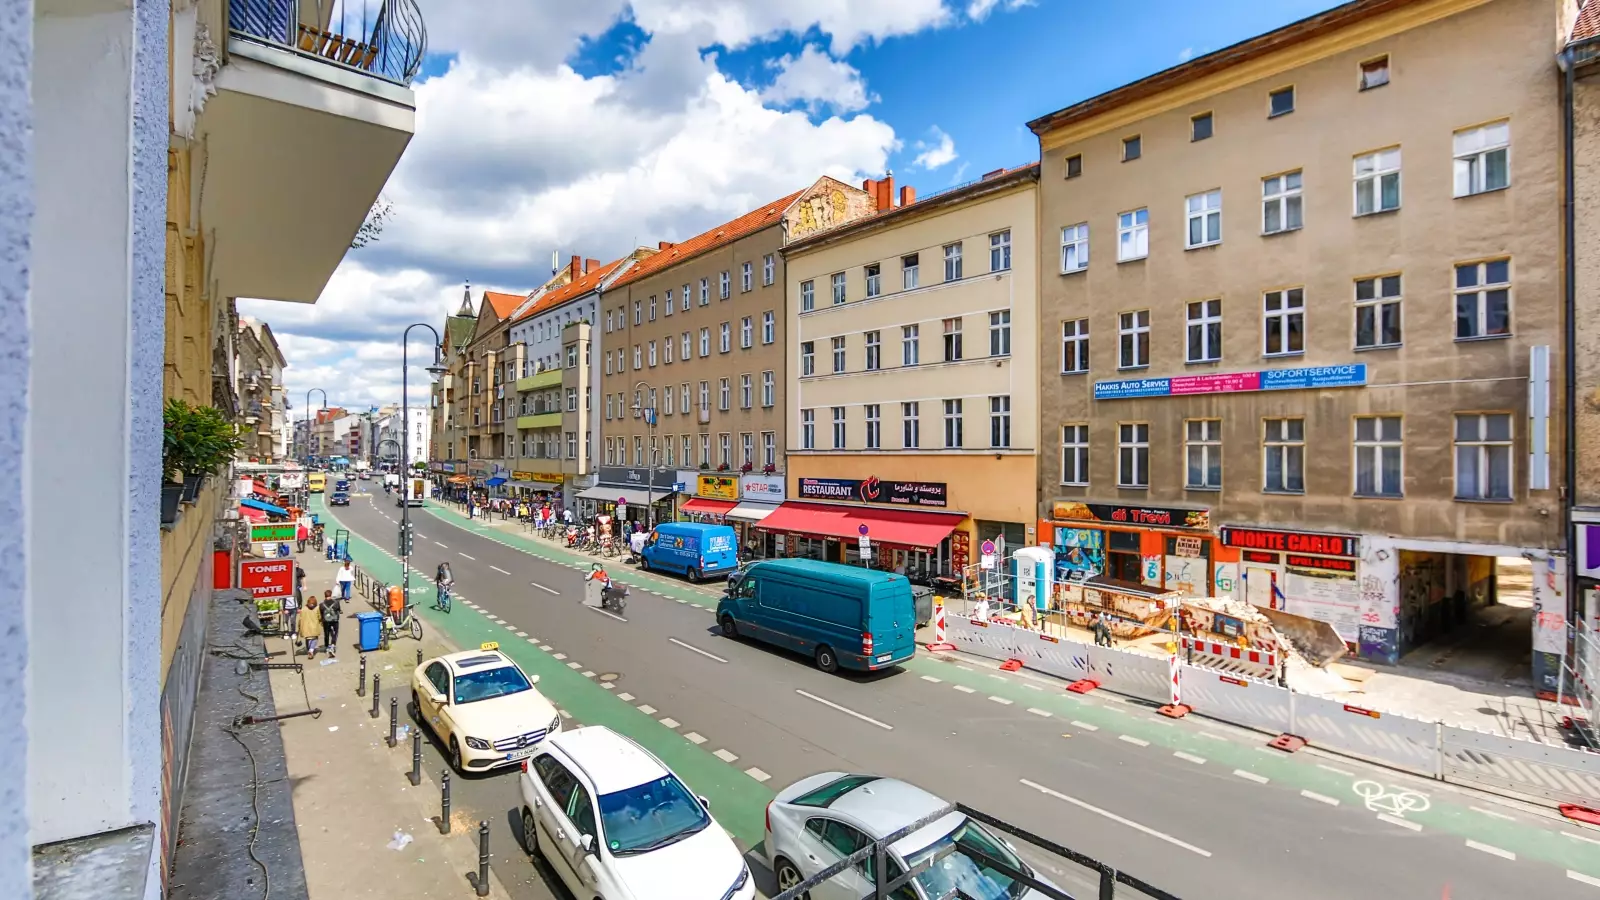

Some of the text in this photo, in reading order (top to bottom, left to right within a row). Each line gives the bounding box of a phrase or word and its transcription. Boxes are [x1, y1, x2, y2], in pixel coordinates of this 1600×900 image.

[1267, 365, 1357, 379] SOFORTSERVICE
[1095, 383, 1120, 391] HAKKIS
[1120, 381, 1140, 390] AUTO
[1141, 380, 1170, 388] SERVICE
[751, 483, 769, 492] STAR
[803, 485, 853, 496] RESTAURANT
[1111, 509, 1171, 524] di Trevi
[1231, 529, 1285, 550] MONTE
[1287, 534, 1343, 555] CARLO
[248, 565, 287, 573] TONER
[262, 575, 272, 583] &
[252, 585, 283, 594] TINTE
